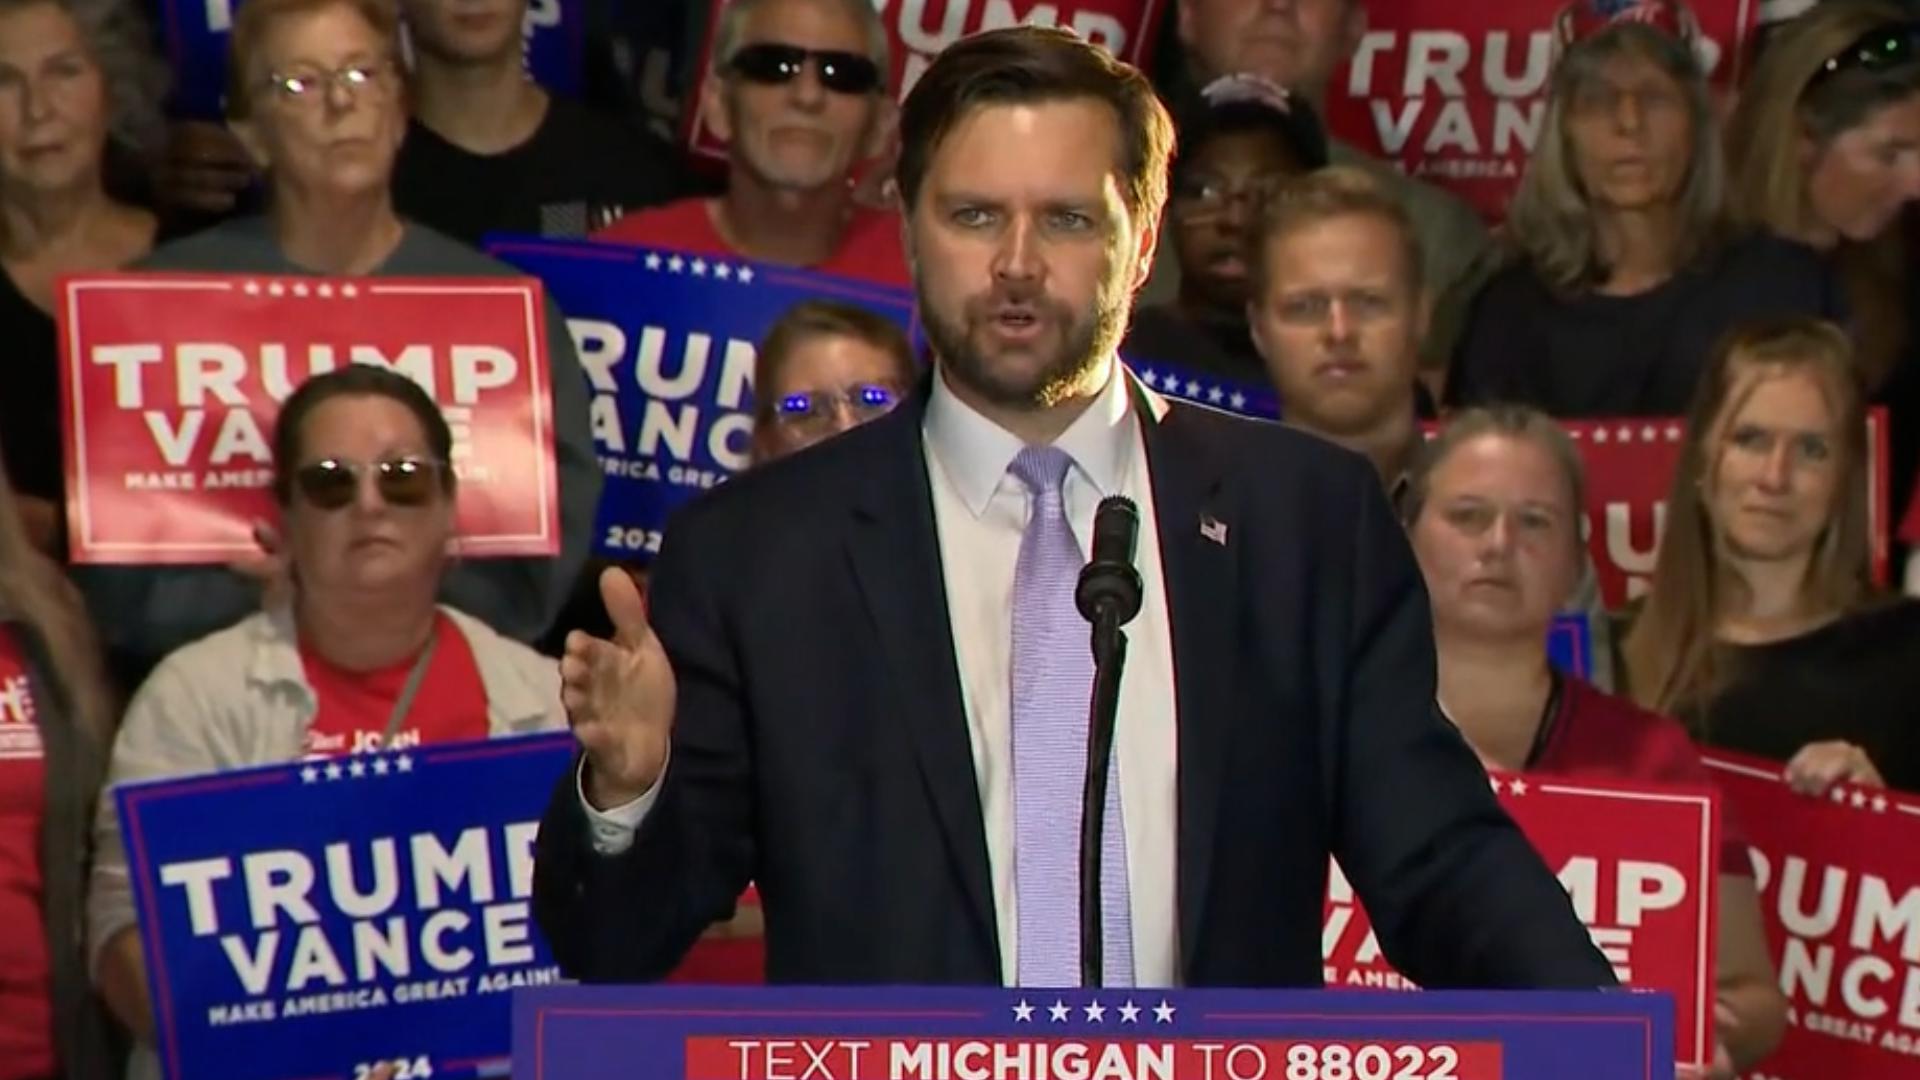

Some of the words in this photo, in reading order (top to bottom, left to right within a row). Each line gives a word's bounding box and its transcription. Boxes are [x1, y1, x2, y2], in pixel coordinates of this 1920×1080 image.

[125, 471, 195, 490] MAKE
[220, 901, 535, 997] VANCE
[208, 1001, 277, 1026] MAKE
[282, 986, 389, 1019] AMERICA
[392, 975, 470, 1004] GREAT
[1804, 1011, 1877, 1044] GREAT
[353, 1054, 433, 1080] 224
[729, 1041, 870, 1080] TEXT
[889, 1042, 1175, 1080] MICHIGAN
[1193, 1044, 1266, 1080] TO
[1286, 1044, 1459, 1080] 88022
